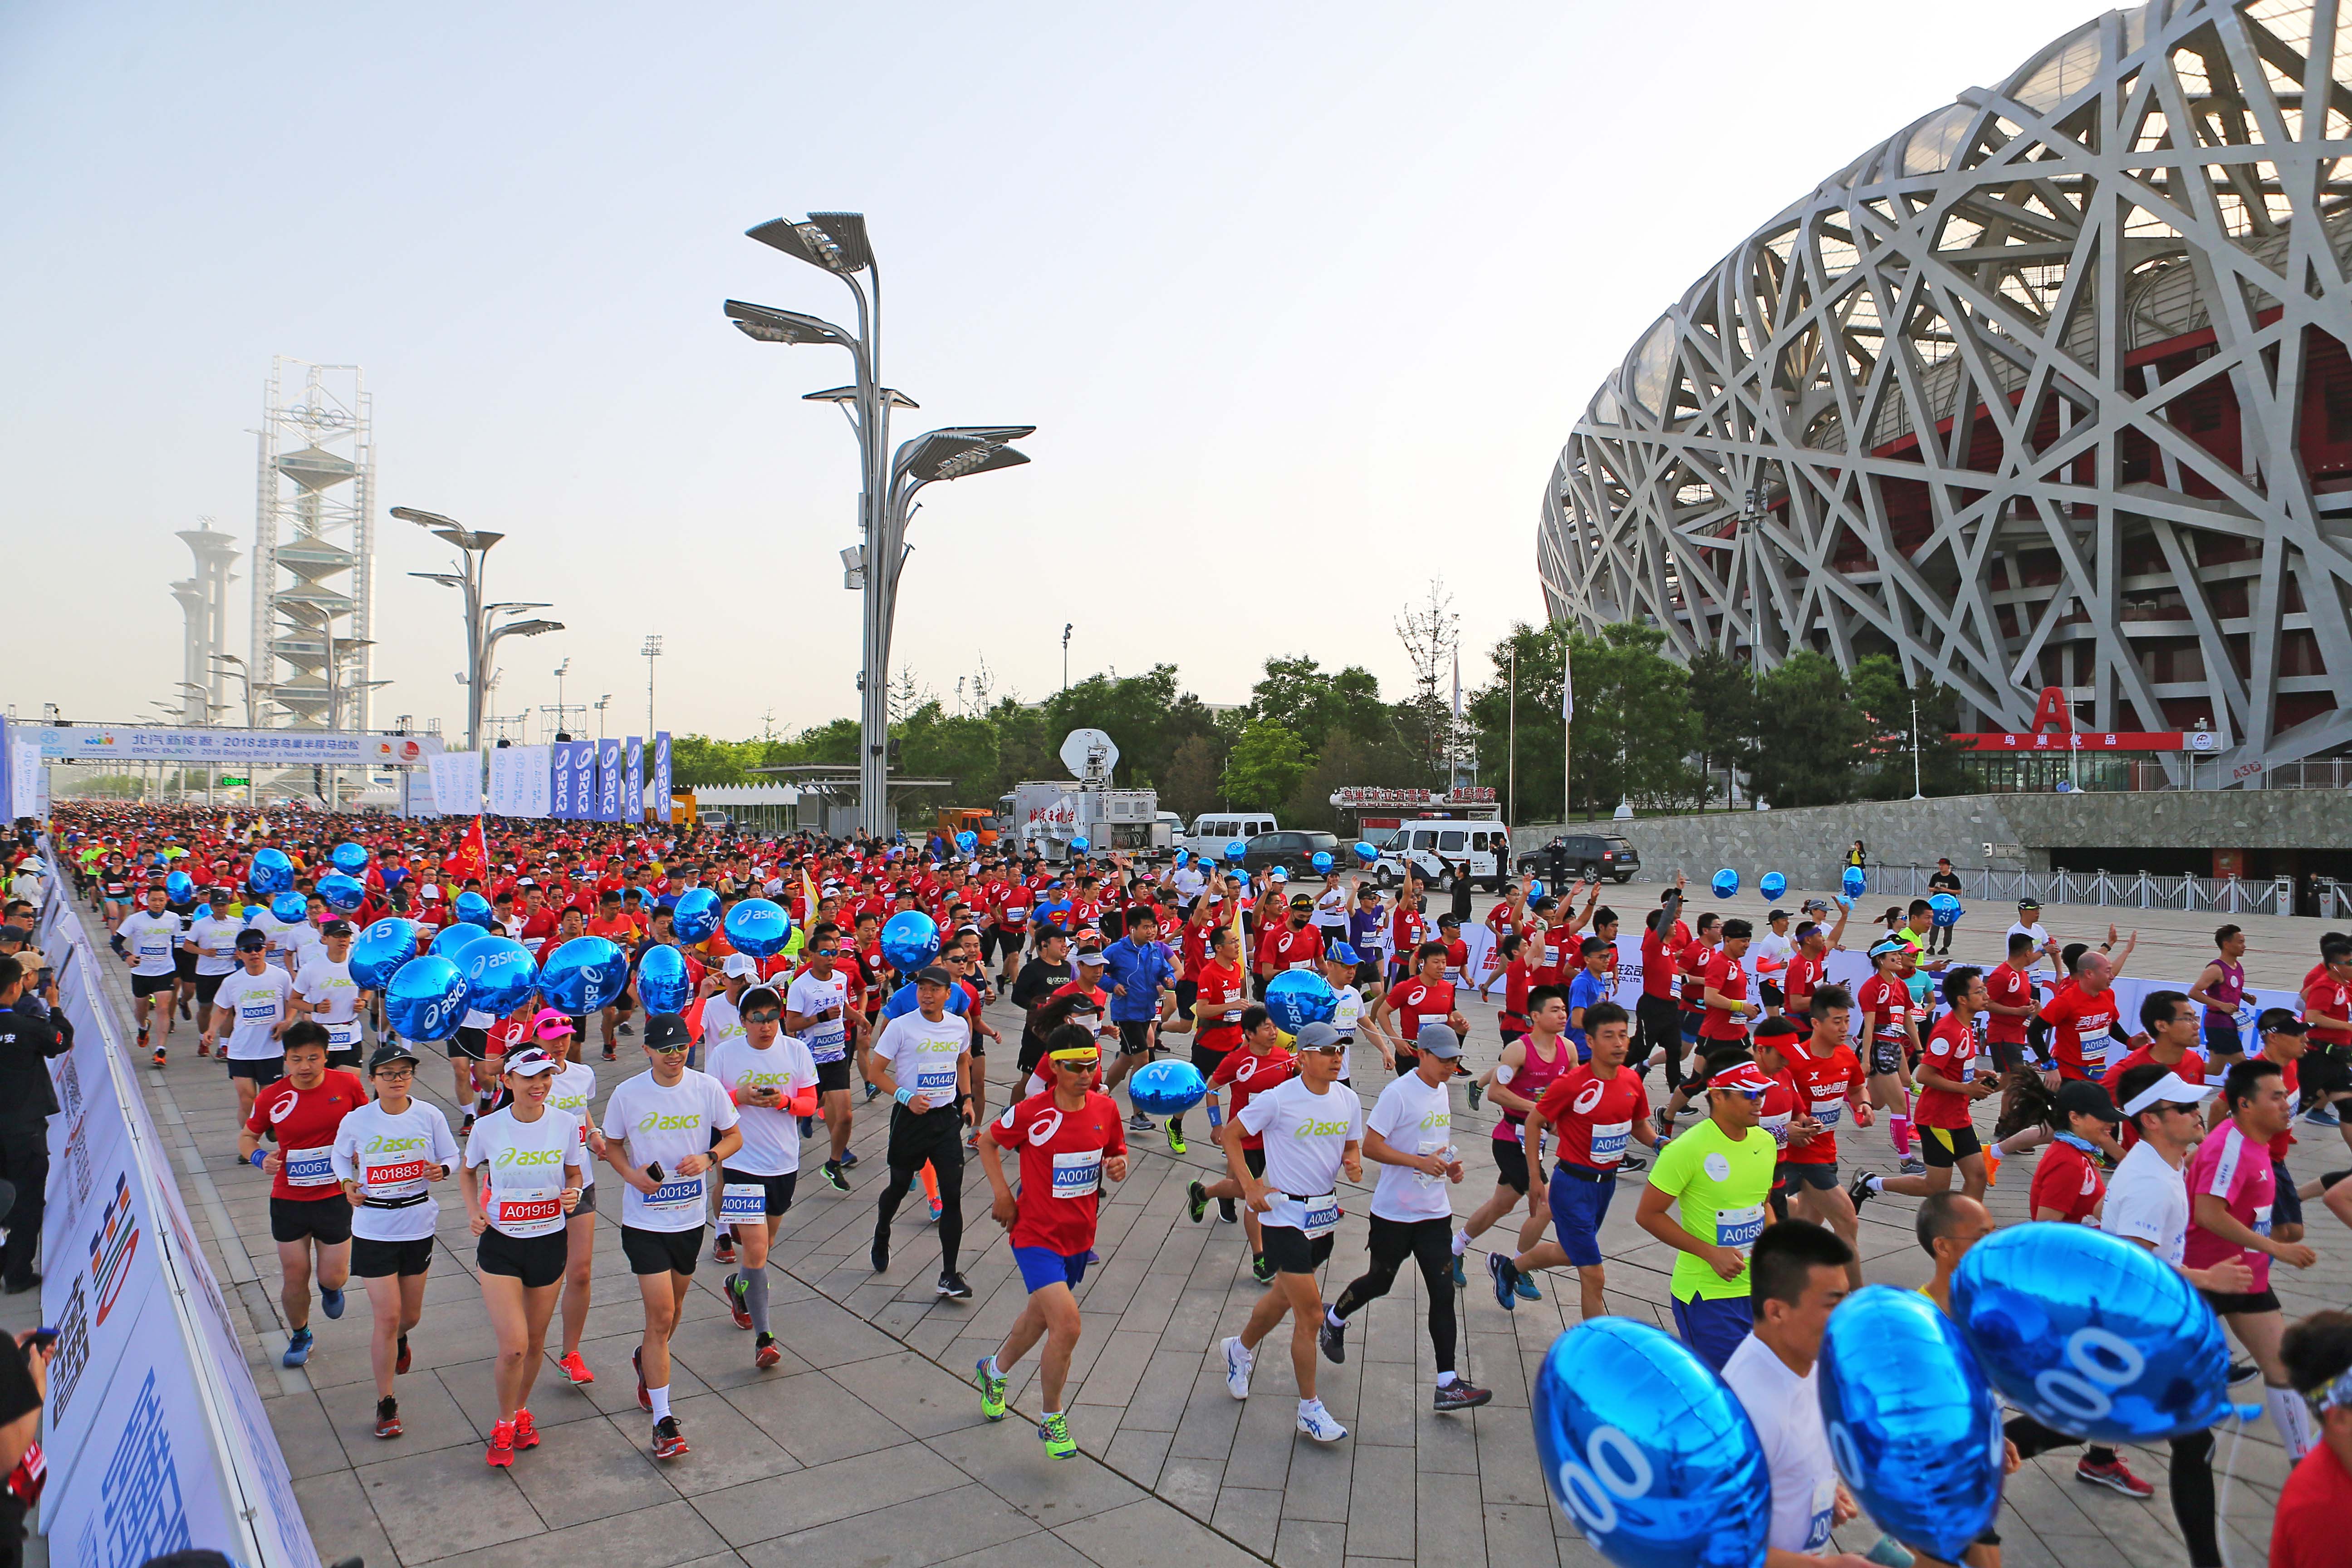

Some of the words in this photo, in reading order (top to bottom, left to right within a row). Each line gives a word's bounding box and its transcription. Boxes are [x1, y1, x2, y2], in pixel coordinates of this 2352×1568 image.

[2031, 686, 2072, 733] A
[132, 734, 212, 746] 北汽新能源
[2004, 735, 2117, 745] 鸟巢优品
[1029, 808, 1075, 824] 北京电视台
[753, 909, 783, 920] asics
[1938, 898, 1952, 922] 2:30
[897, 926, 940, 951] 2:15
[489, 950, 527, 968] asics
[333, 978, 356, 988] asic
[440, 978, 467, 1015] asics
[583, 983, 598, 1014] asics
[243, 1005, 274, 1018] A00149
[0, 1034, 15, 1044] 安
[817, 1032, 844, 1045] A00002
[932, 1042, 959, 1053] asics
[754, 1072, 790, 1085] asics
[921, 1074, 954, 1086] A01445
[658, 1114, 701, 1131] asics
[1314, 1121, 1348, 1136] asics
[1435, 1114, 1451, 1127] asic
[383, 1137, 425, 1153] asics
[516, 1148, 563, 1166] asics
[289, 1161, 331, 1176] A0067
[370, 1164, 420, 1181] A01883
[1057, 1165, 1100, 1183] A00178
[648, 1183, 698, 1200] A00134
[504, 1201, 557, 1219] A01915
[721, 1199, 762, 1210] A00144
[101, 1365, 193, 1568] 时博国
